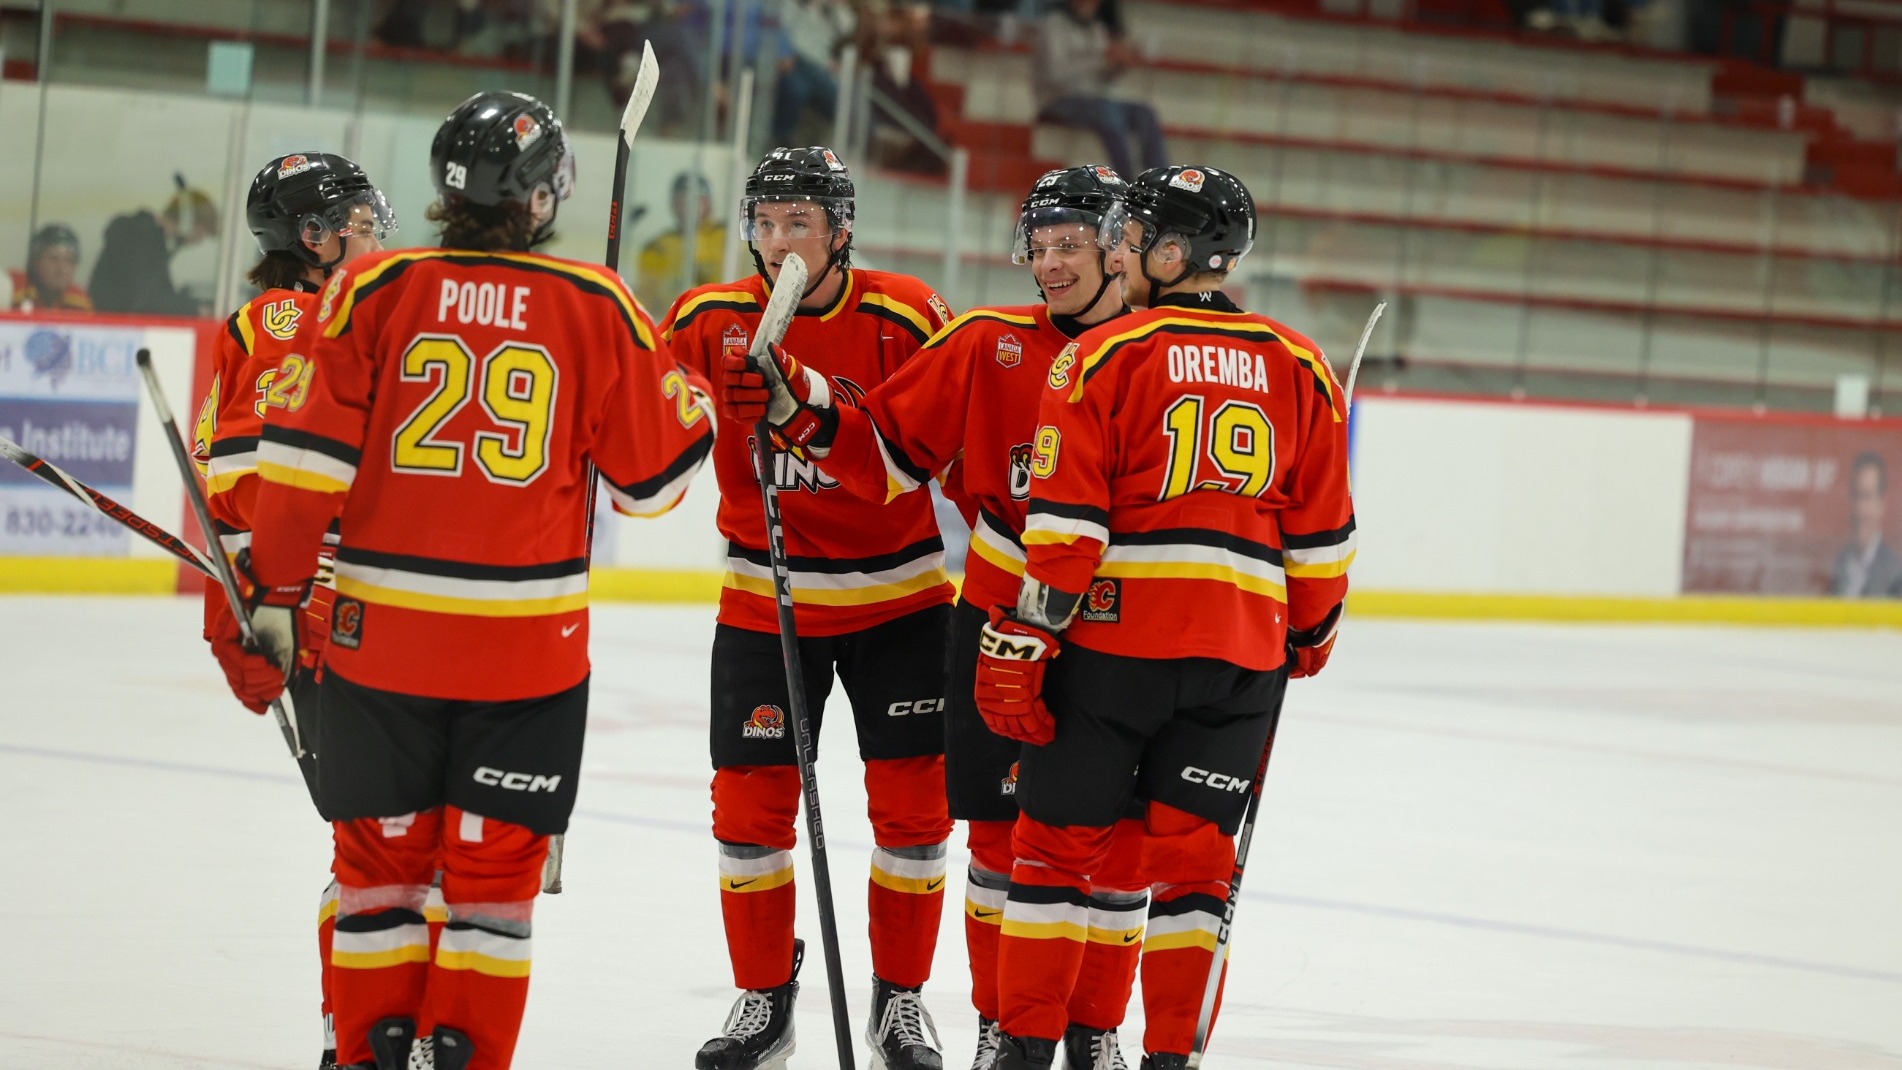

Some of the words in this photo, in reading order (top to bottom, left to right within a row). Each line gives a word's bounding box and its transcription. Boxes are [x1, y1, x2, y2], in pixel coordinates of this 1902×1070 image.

[278, 163, 310, 180] DINOS
[446, 161, 467, 190] 29
[763, 174, 796, 182] CCM
[1169, 178, 1202, 193] DINOS
[1030, 198, 1060, 209] CCM
[437, 278, 531, 331] POOLE
[262, 299, 303, 340] UC
[998, 350, 1019, 363] WEST
[999, 341, 1021, 352] CANADA
[1167, 345, 1269, 394] OREMBA
[391, 331, 560, 488] 29
[22, 420, 131, 461] Institute
[798, 422, 816, 442] CCM
[1031, 424, 1062, 480] 9
[1157, 393, 1275, 502] 19
[1083, 610, 1118, 622] Foundation
[980, 629, 1038, 660] CM
[742, 724, 785, 739] DINOS
[473, 766, 563, 793] CCM
[800, 717, 826, 850] UNLEASHED
[1180, 765, 1250, 794] CCM
[1216, 884, 1240, 946] CCM
